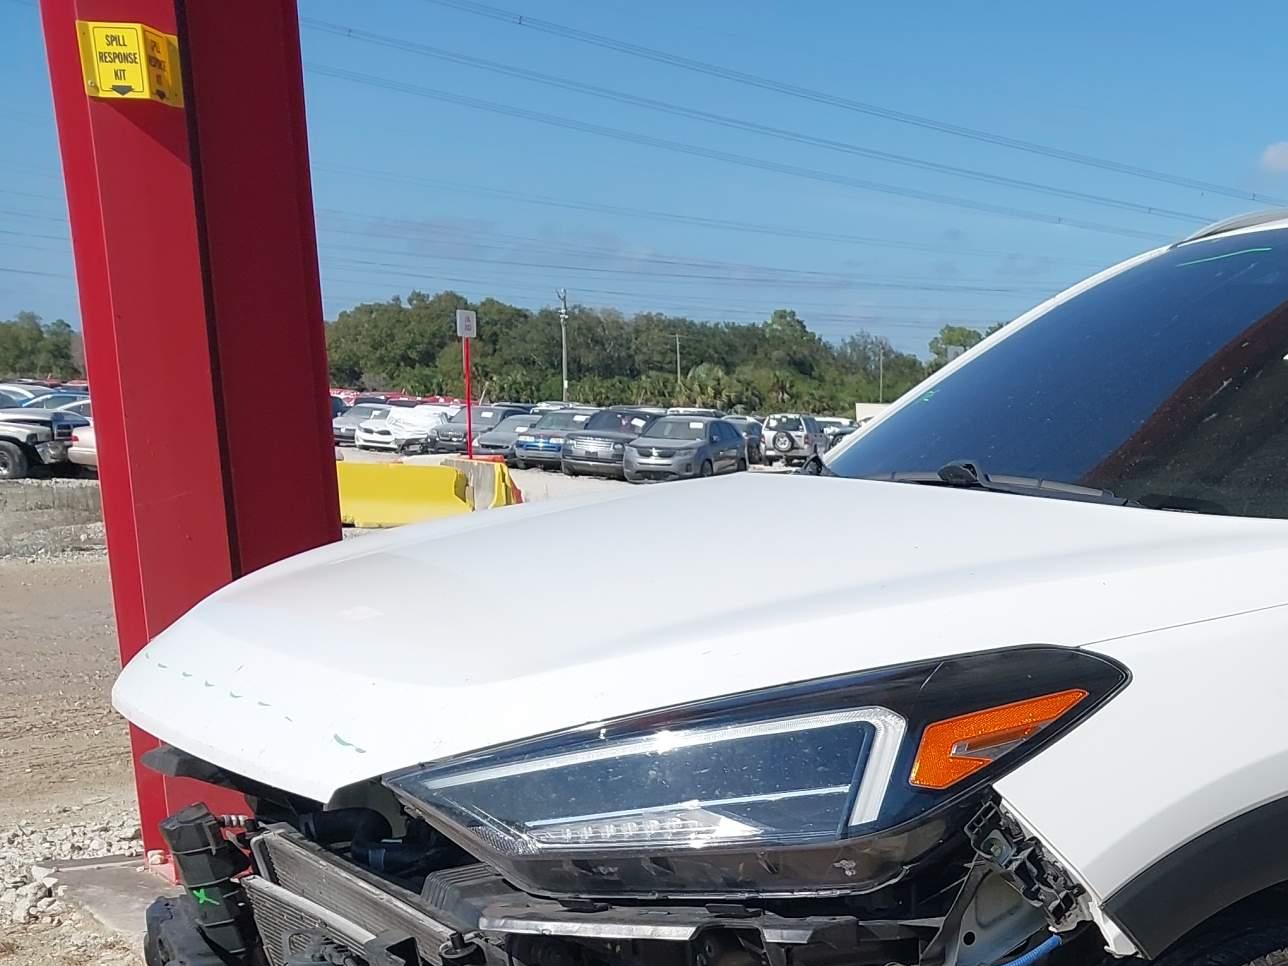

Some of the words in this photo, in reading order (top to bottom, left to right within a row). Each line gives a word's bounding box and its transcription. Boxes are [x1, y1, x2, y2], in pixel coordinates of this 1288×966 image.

[105, 34, 128, 47] SPILL
[98, 51, 139, 65] RESPONSE
[113, 69, 127, 81] KIT
